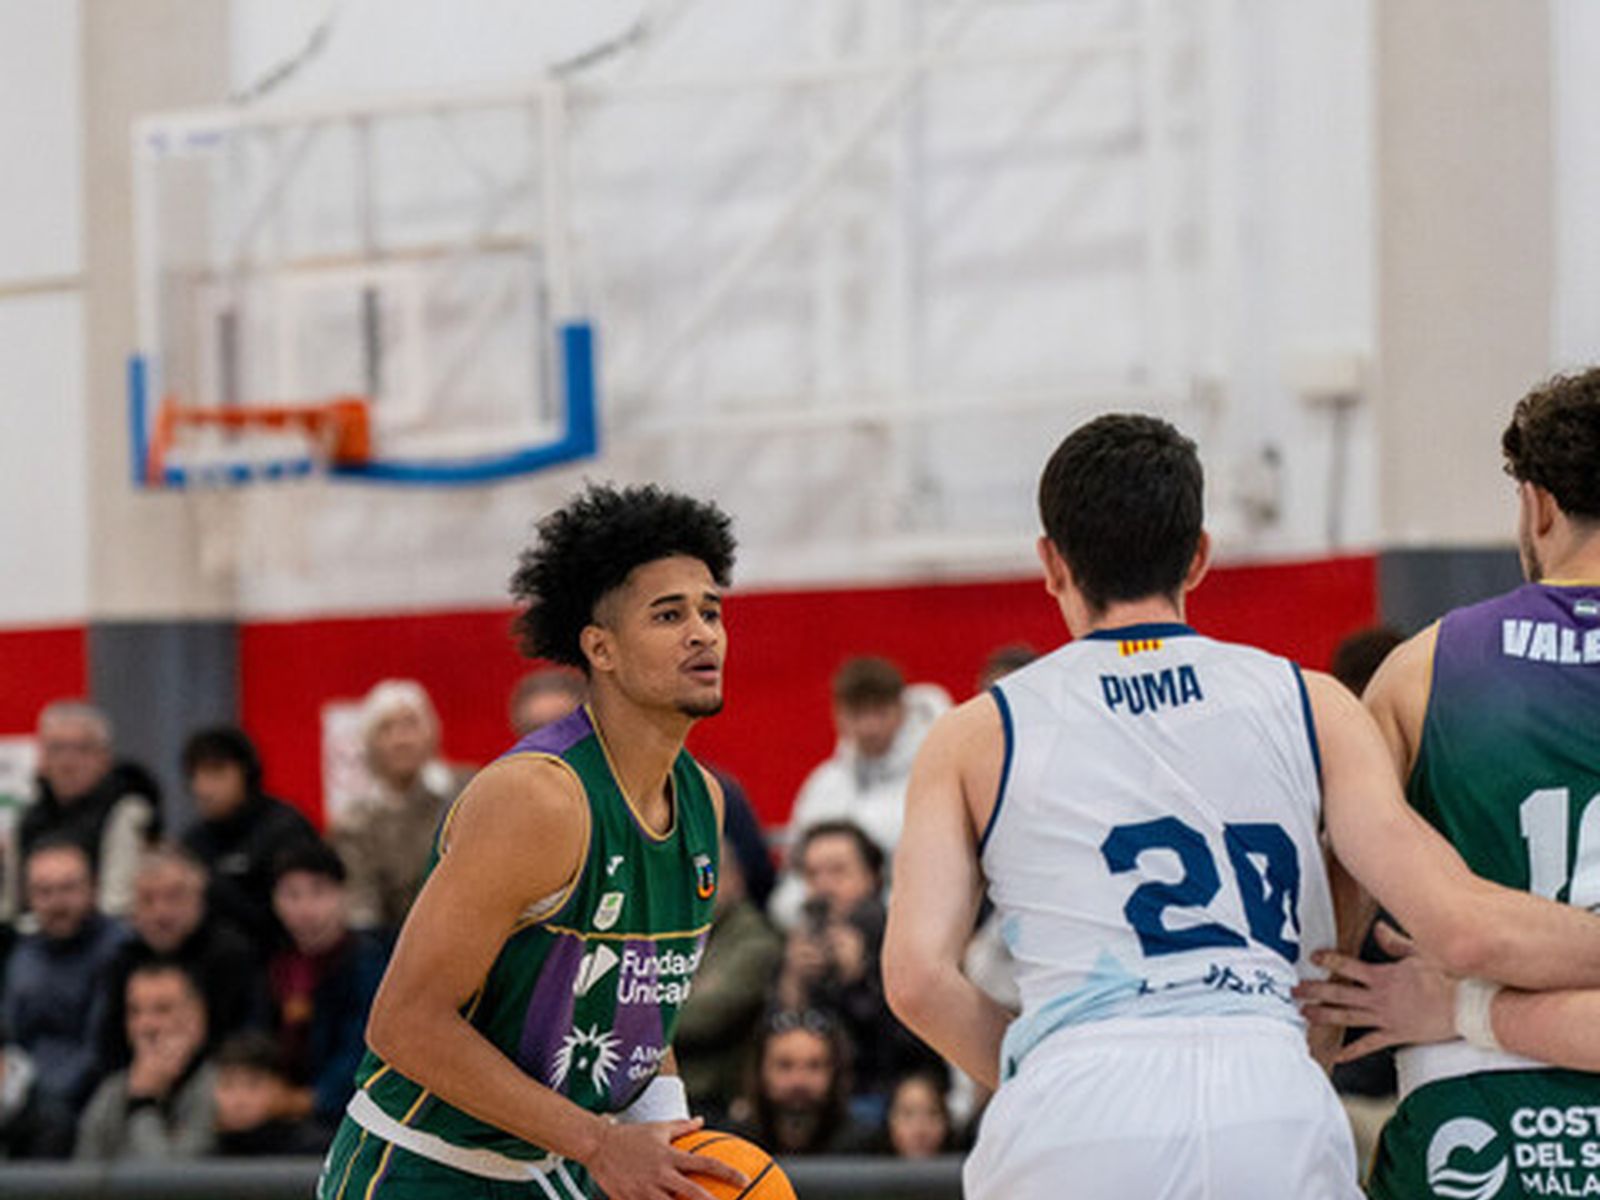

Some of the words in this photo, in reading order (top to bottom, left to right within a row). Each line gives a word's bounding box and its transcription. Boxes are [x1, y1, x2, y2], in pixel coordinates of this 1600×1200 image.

[1100, 665, 1204, 716] PUMA
[1100, 816, 1300, 964] 20
[1514, 1143, 1575, 1167] DEL
